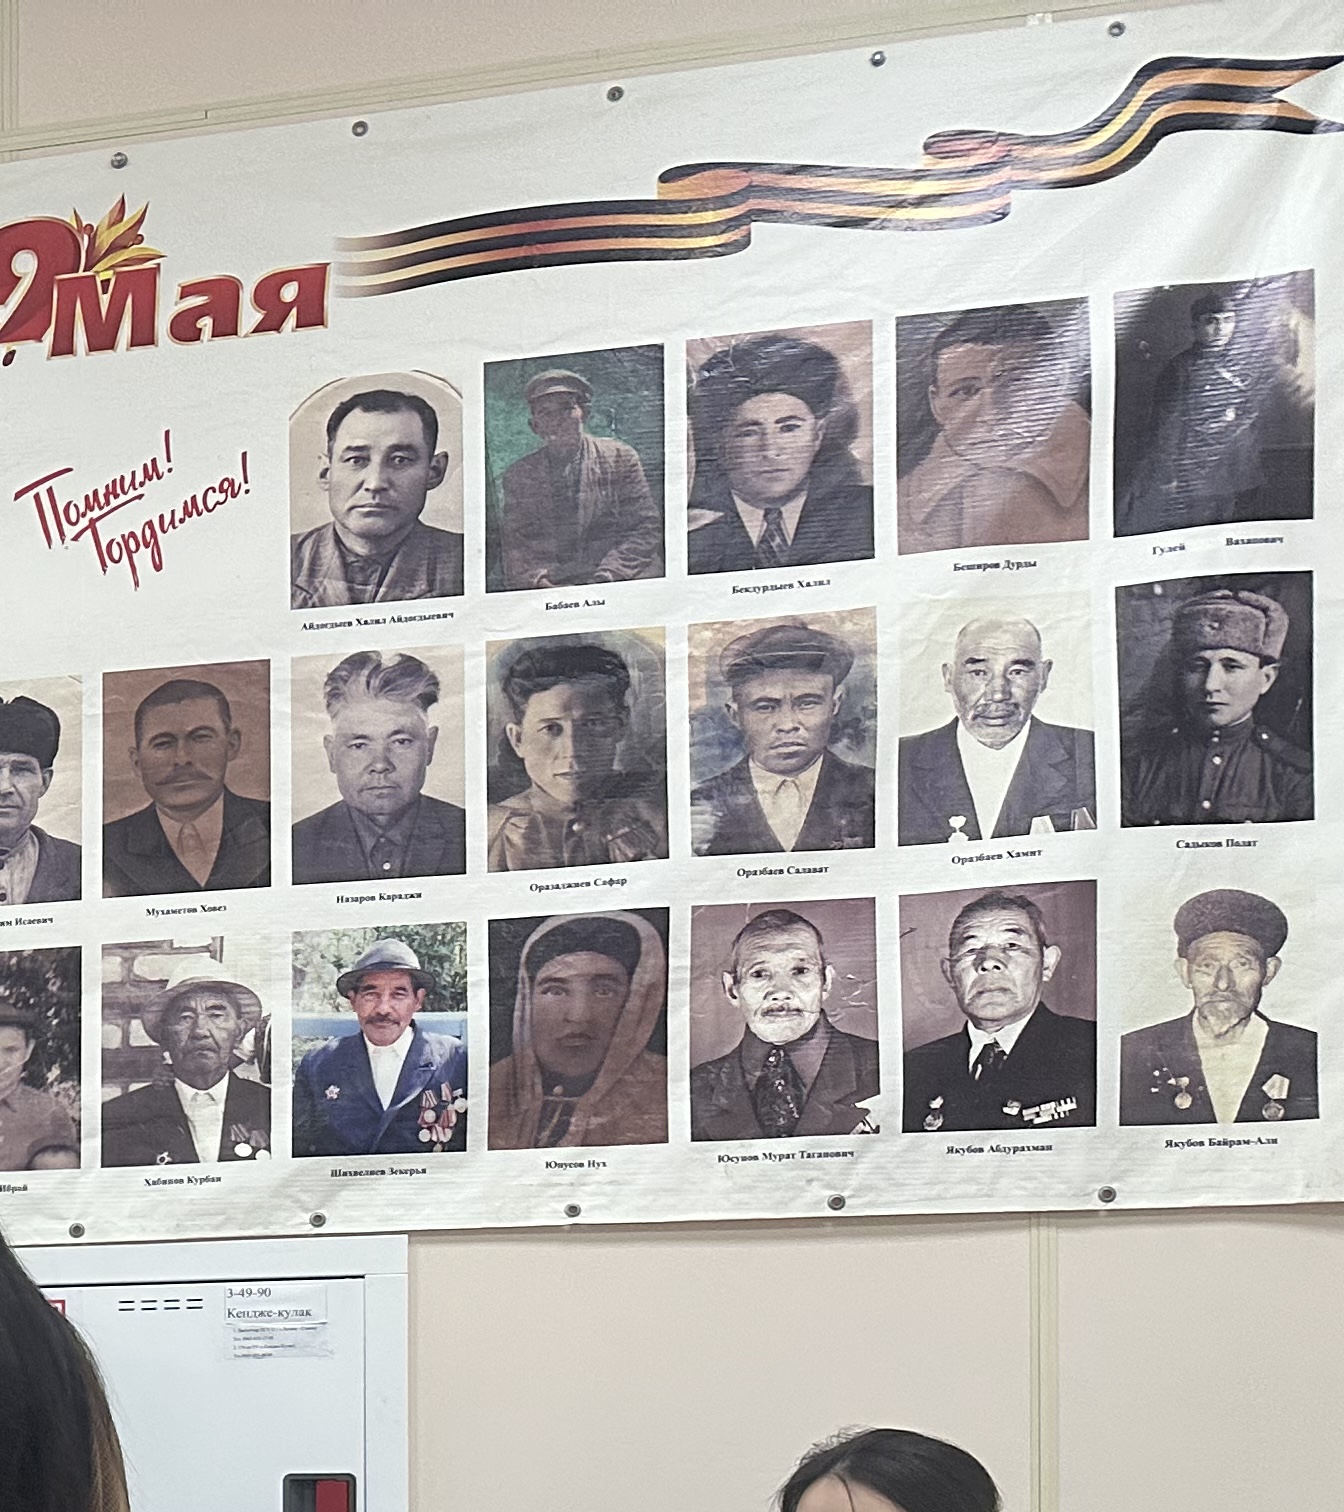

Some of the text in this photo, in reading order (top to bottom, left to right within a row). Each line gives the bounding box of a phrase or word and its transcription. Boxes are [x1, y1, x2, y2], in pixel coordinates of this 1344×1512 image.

[47, 262, 332, 361] Мая
[13, 429, 174, 550] Помним!
[70, 451, 251, 592] Гордимся!
[545, 600, 580, 611] Бабаев
[355, 617, 386, 627] Халил
[336, 895, 376, 904] Назаров
[945, 1144, 985, 1156] Якубов
[1164, 1139, 1205, 1150] Якубов
[761, 1152, 797, 1162] Мурат
[187, 1175, 222, 1186] Курбан
[226, 1287, 272, 1299] 3-49-90
[227, 1307, 312, 1320] Кендже-кулак
